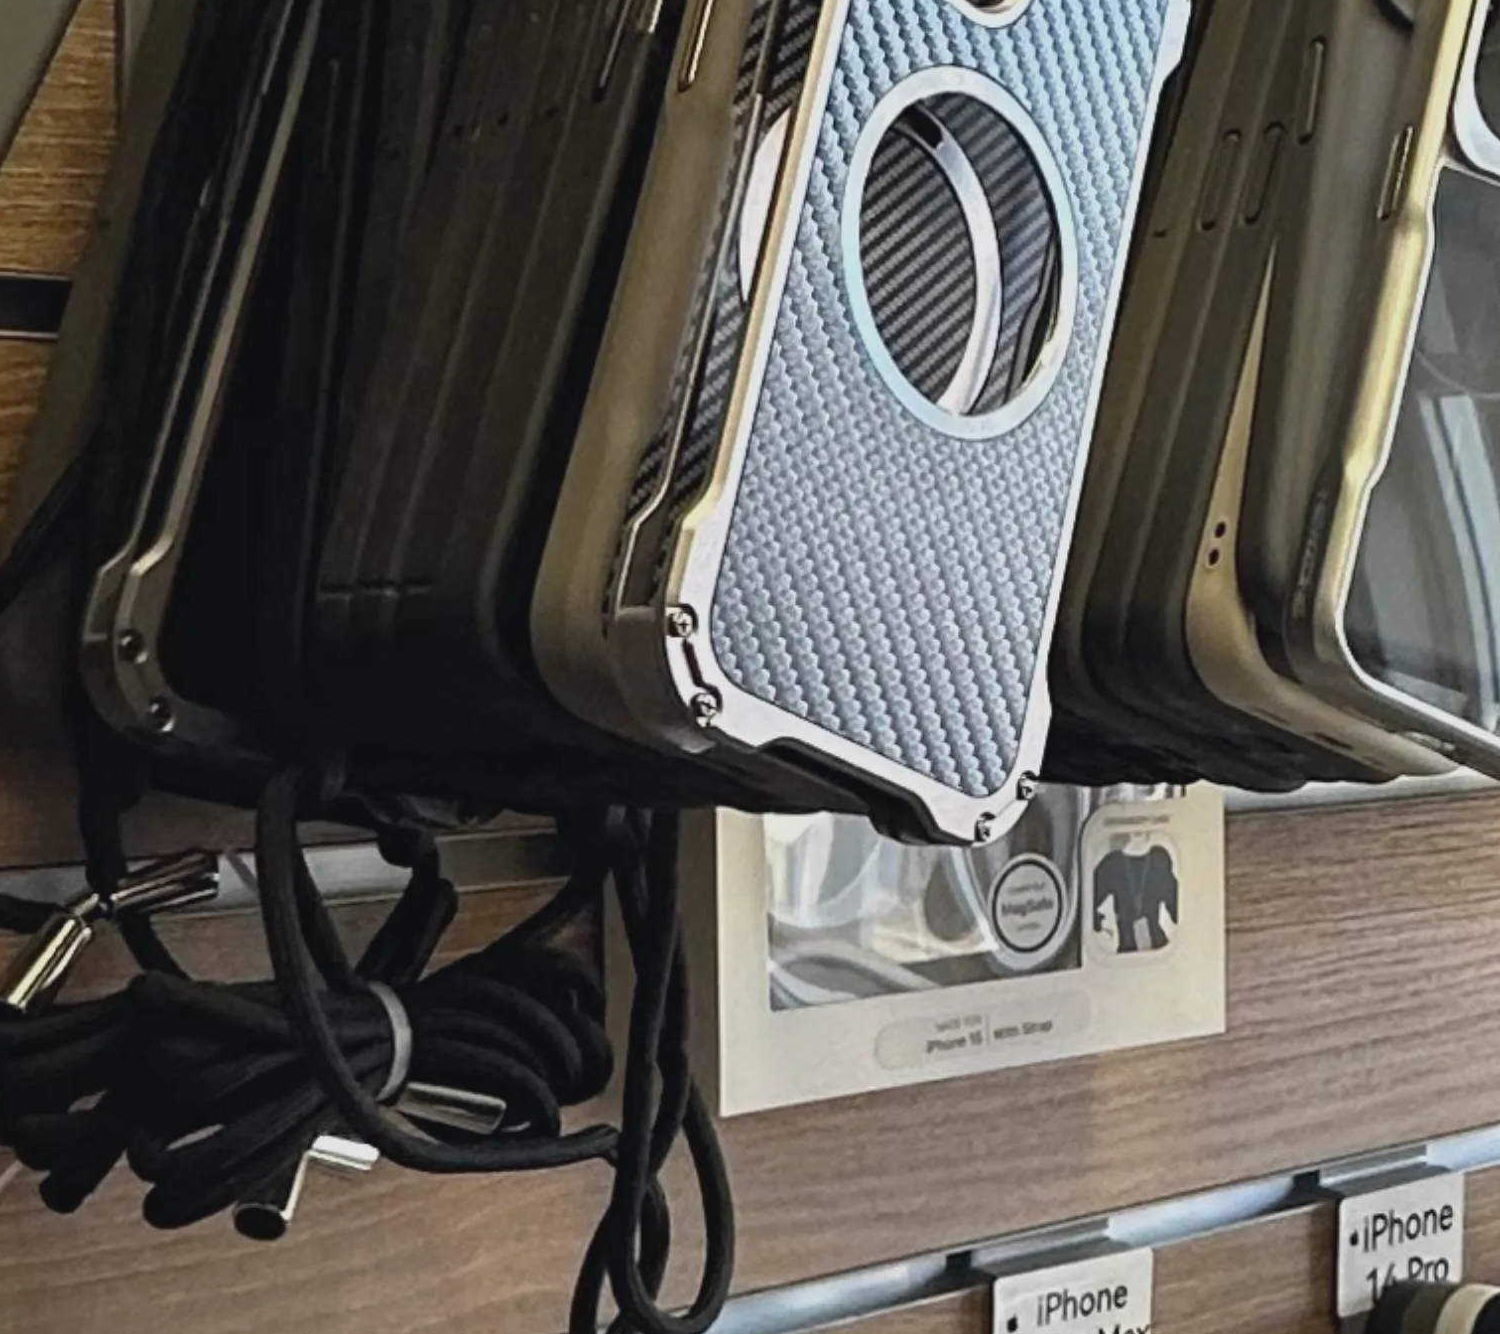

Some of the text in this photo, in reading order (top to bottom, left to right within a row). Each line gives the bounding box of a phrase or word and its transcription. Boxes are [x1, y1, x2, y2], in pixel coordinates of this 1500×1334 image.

[1363, 1201, 1455, 1255] iPhone
[1406, 1257, 1449, 1285] Pro
[1036, 1279, 1128, 1328] iPhone
